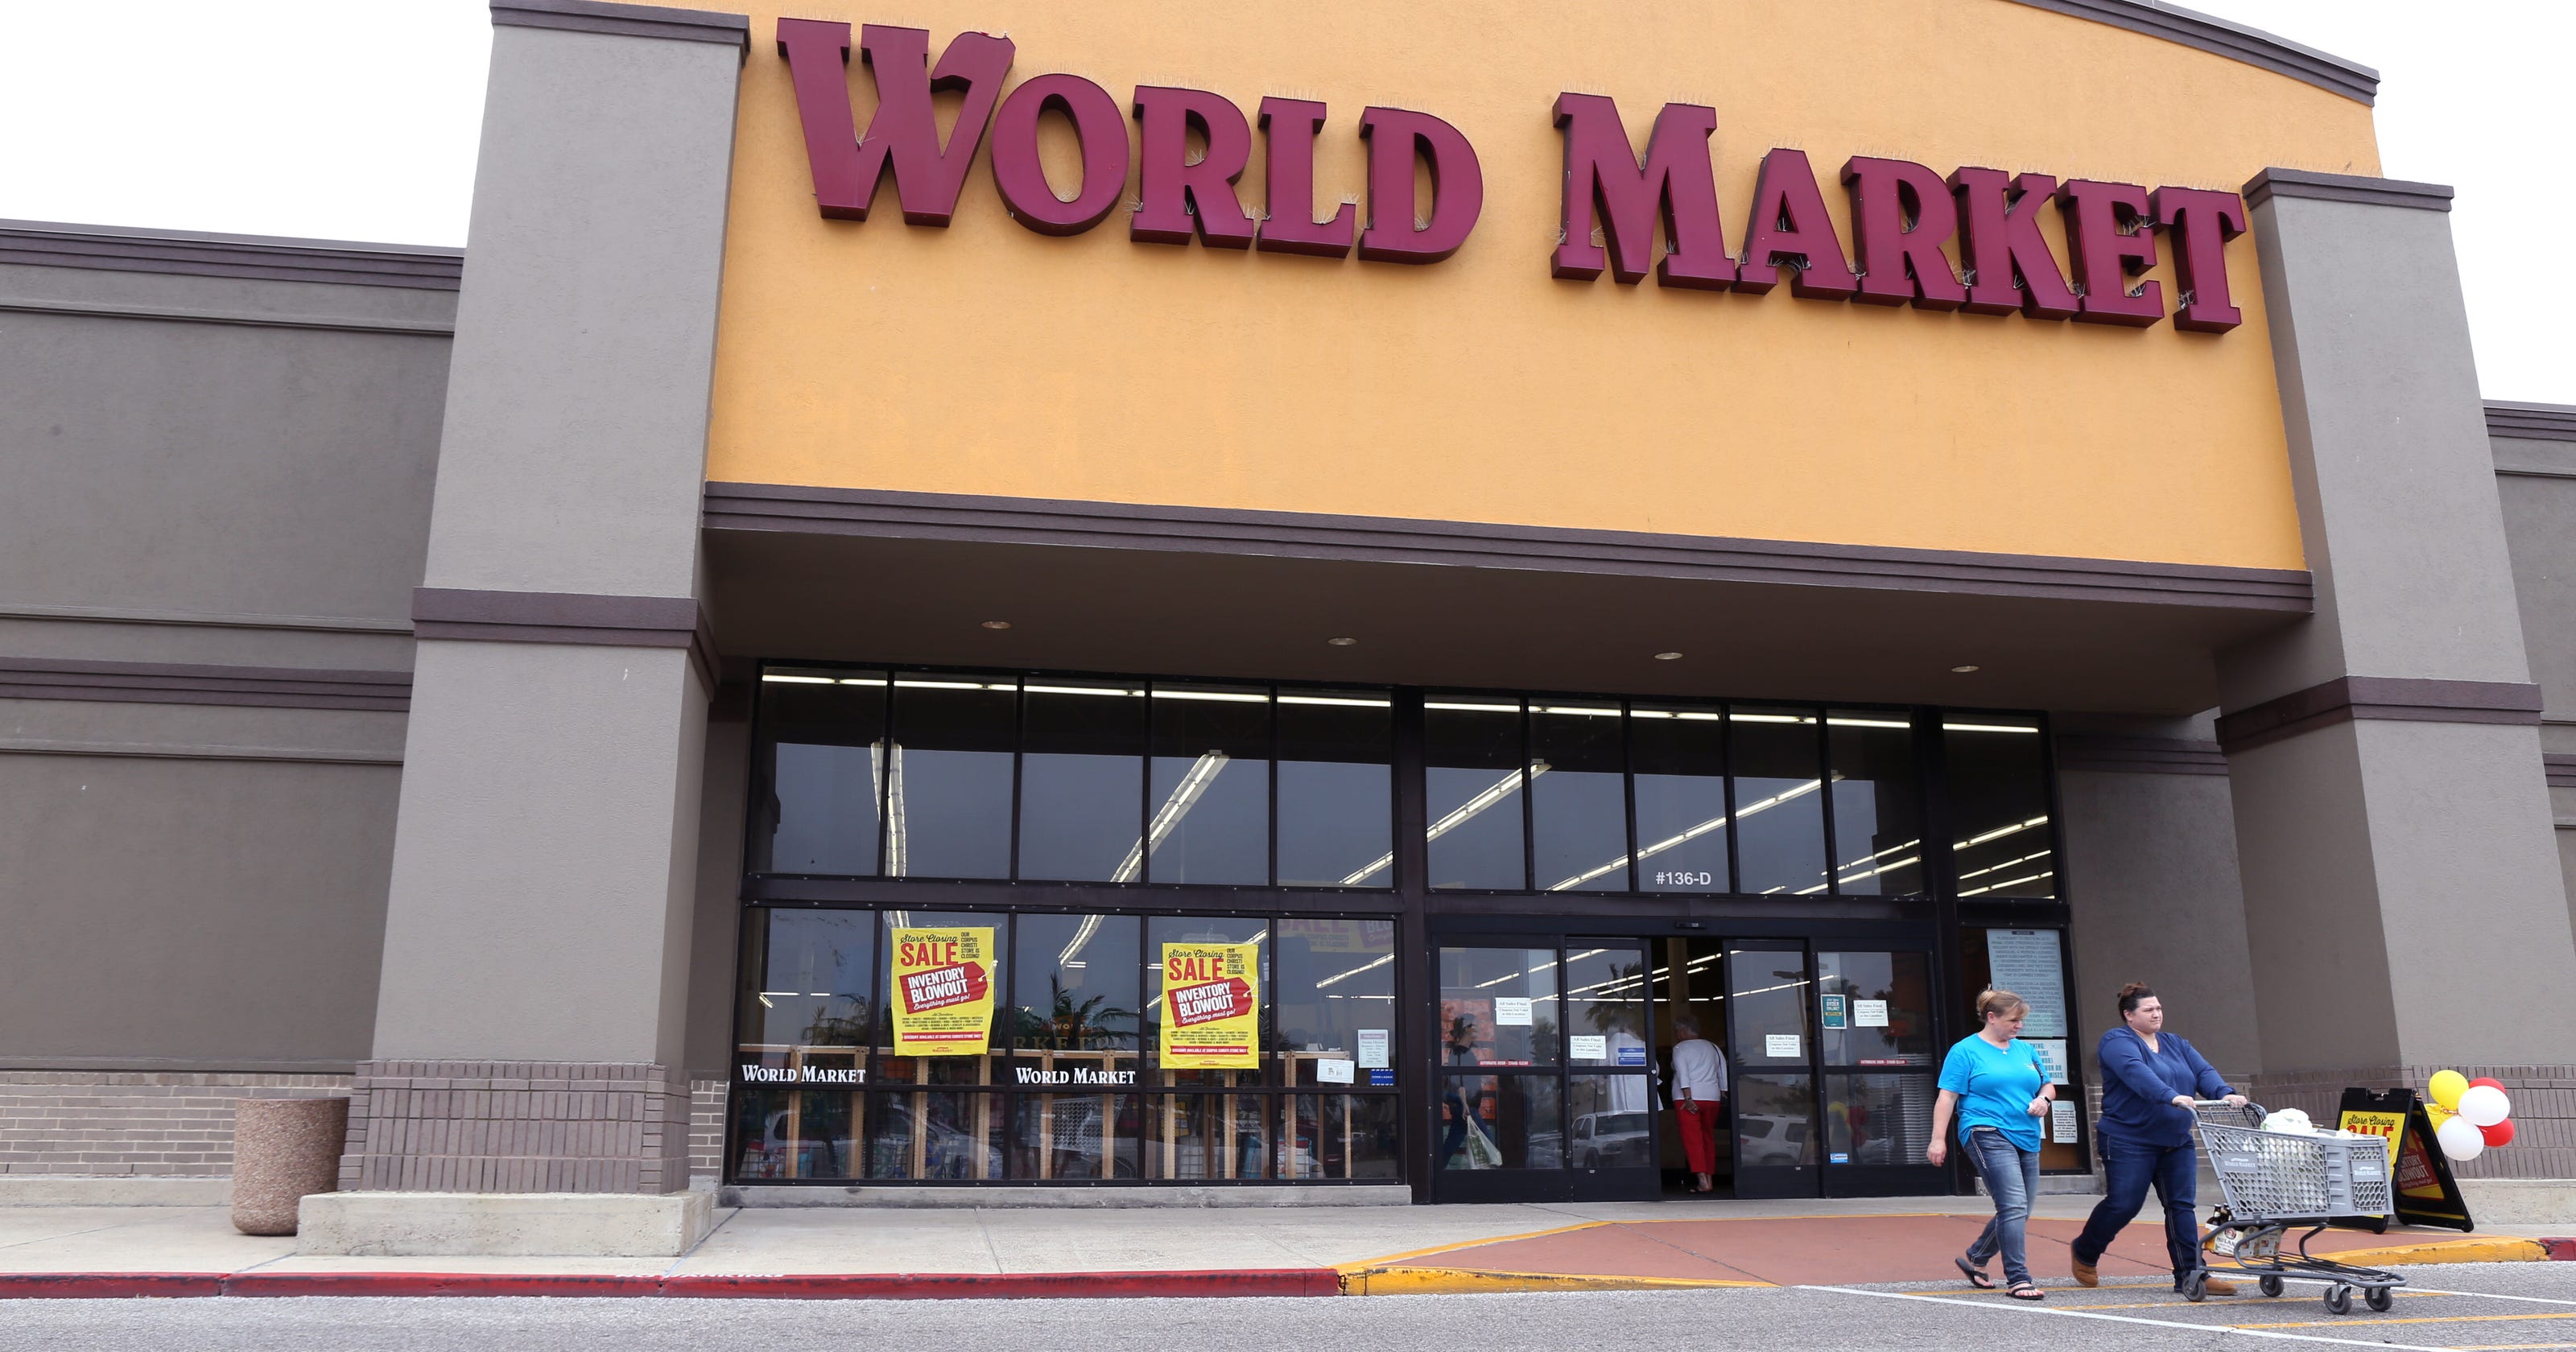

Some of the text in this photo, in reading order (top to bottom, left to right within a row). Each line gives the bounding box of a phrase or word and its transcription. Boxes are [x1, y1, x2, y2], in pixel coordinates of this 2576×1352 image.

[777, 17, 2246, 334] WORLD MARKET
[1655, 872, 1711, 885] #136-D
[900, 934, 958, 944] Store Closing
[900, 942, 959, 967] SALE
[1169, 949, 1224, 958] Store Closing
[907, 967, 964, 989] INVENTORY
[1169, 958, 1224, 981] SALE
[910, 979, 968, 1004] BLOWOUT
[1175, 982, 1230, 1004] INVENTORY
[913, 994, 970, 1010] Everything must go!
[1179, 994, 1233, 1017] BLOWOUT
[1182, 1008, 1236, 1024] Everything must go!
[742, 1064, 865, 1083] WORLD MARKET
[1015, 1067, 1136, 1084] WORLD MARKET
[2347, 1114, 2395, 1126] Store Closing
